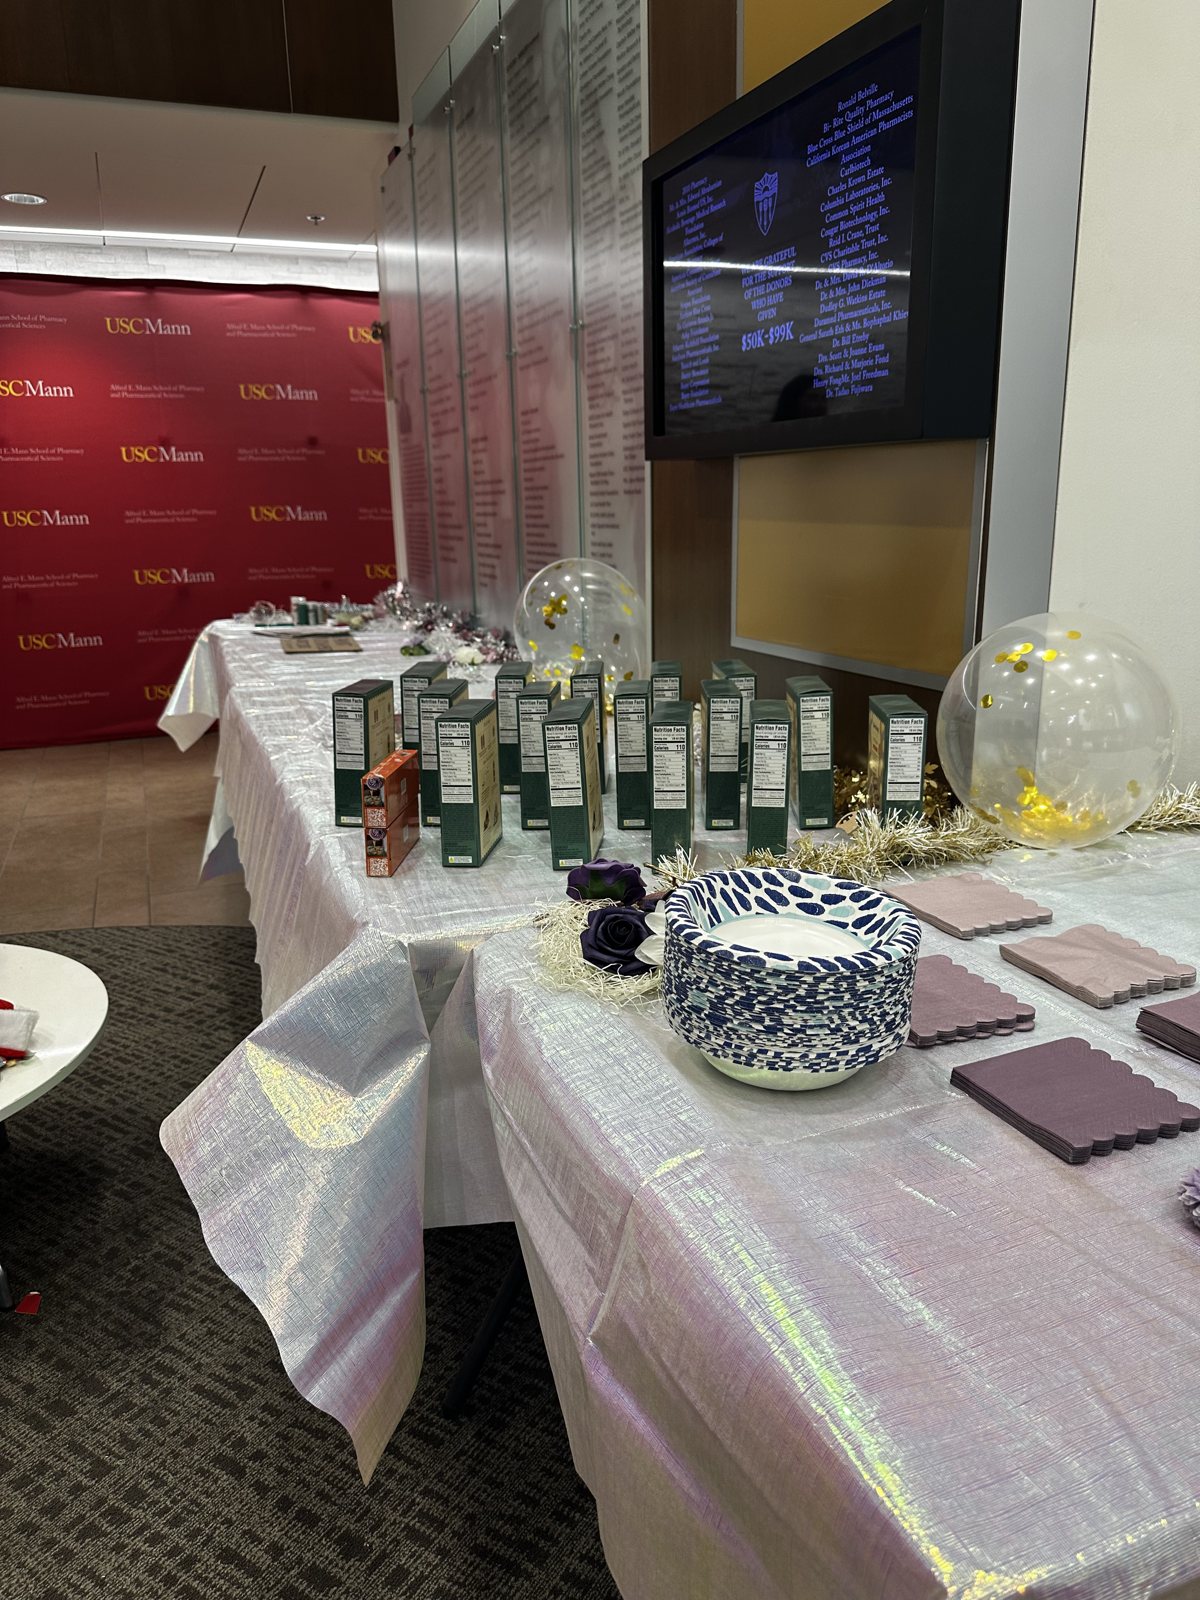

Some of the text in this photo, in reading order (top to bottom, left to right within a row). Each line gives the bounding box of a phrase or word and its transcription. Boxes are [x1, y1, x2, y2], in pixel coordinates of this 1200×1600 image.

[833, 116, 844, 127] Rite
[845, 106, 865, 123] Quality
[866, 92, 894, 109] Pharmacy
[837, 93, 857, 112] Ronald
[807, 144, 818, 154] Blue
[819, 135, 833, 149] Cross
[834, 130, 846, 141] Blue
[847, 119, 864, 134] Shield
[872, 95, 913, 121] Massachusetts
[807, 110, 913, 165] California Korean American Pharmacists
[841, 146, 871, 164] Association
[828, 182, 847, 196] Charles
[867, 166, 885, 180] Estate
[820, 197, 845, 212] Columbia
[845, 183, 881, 202] Laboratories,
[825, 193, 885, 222] Common Spirit Health
[839, 210, 878, 231] Biotechnology,
[865, 224, 880, 233] Trust
[763, 247, 795, 267] GRATEFUL
[820, 252, 833, 262] CVS
[833, 243, 860, 258] Charitable
[861, 238, 877, 250] Trust,
[841, 255, 868, 269] Pharmacy,
[742, 275, 754, 286] FOR
[755, 271, 767, 281] THE
[752, 284, 765, 296] THE
[766, 276, 792, 291] DONORS
[751, 292, 783, 309] WHO HAVE
[758, 308, 777, 320] GIVEN
[104, 317, 192, 335] USCMann
[742, 321, 794, 351] $50K-$99K
[0, 379, 74, 397] SCMann
[239, 383, 319, 400] USCMann
[120, 446, 204, 463] USCMann
[1, 509, 90, 527] USCMann
[250, 505, 328, 522] USCMann
[133, 568, 215, 585] USCMann
[18, 632, 103, 650] USCMann
